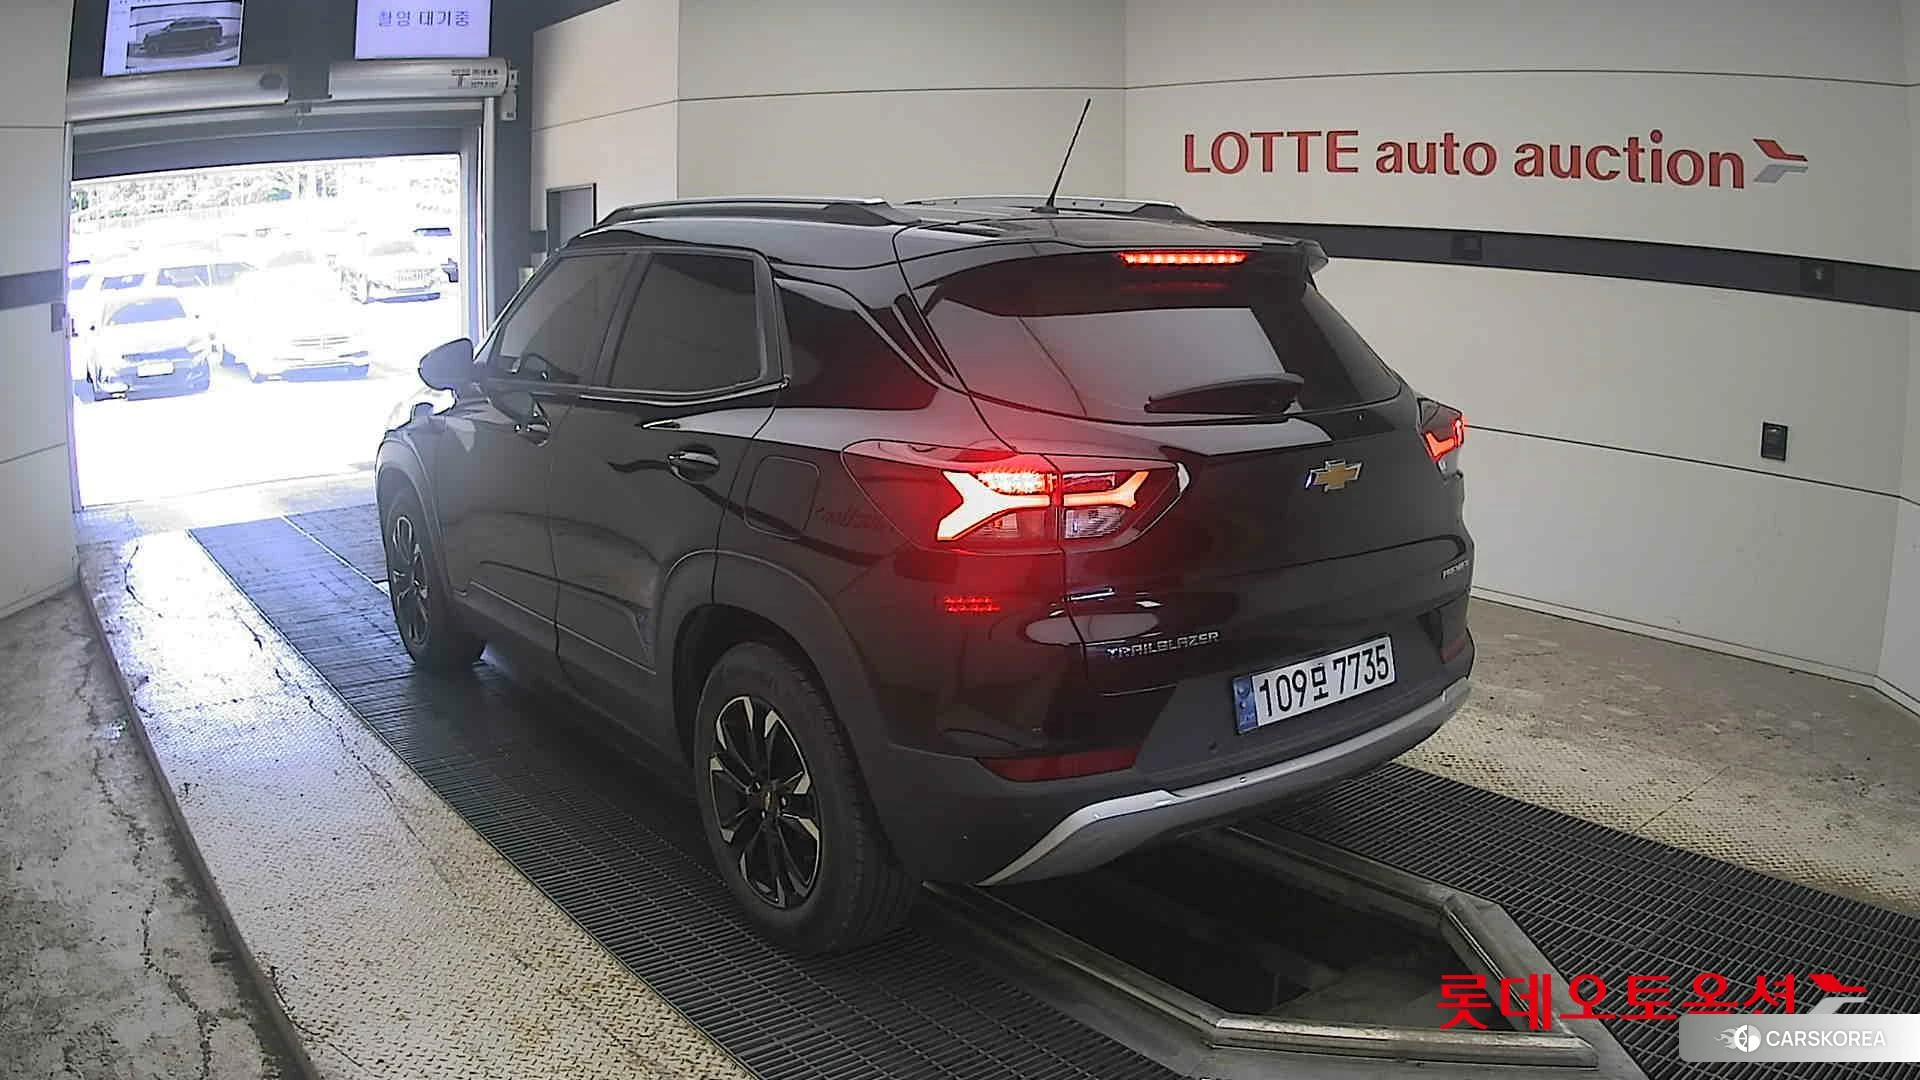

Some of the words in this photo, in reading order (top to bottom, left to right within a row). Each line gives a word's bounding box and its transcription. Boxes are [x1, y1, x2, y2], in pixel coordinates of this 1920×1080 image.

[419, 10, 470, 27] 대기중
[1184, 130, 1359, 174] LOTTE
[1376, 132, 1498, 176] auto
[1513, 129, 1745, 189] auction
[1106, 631, 1220, 658] TRAILBLAZER
